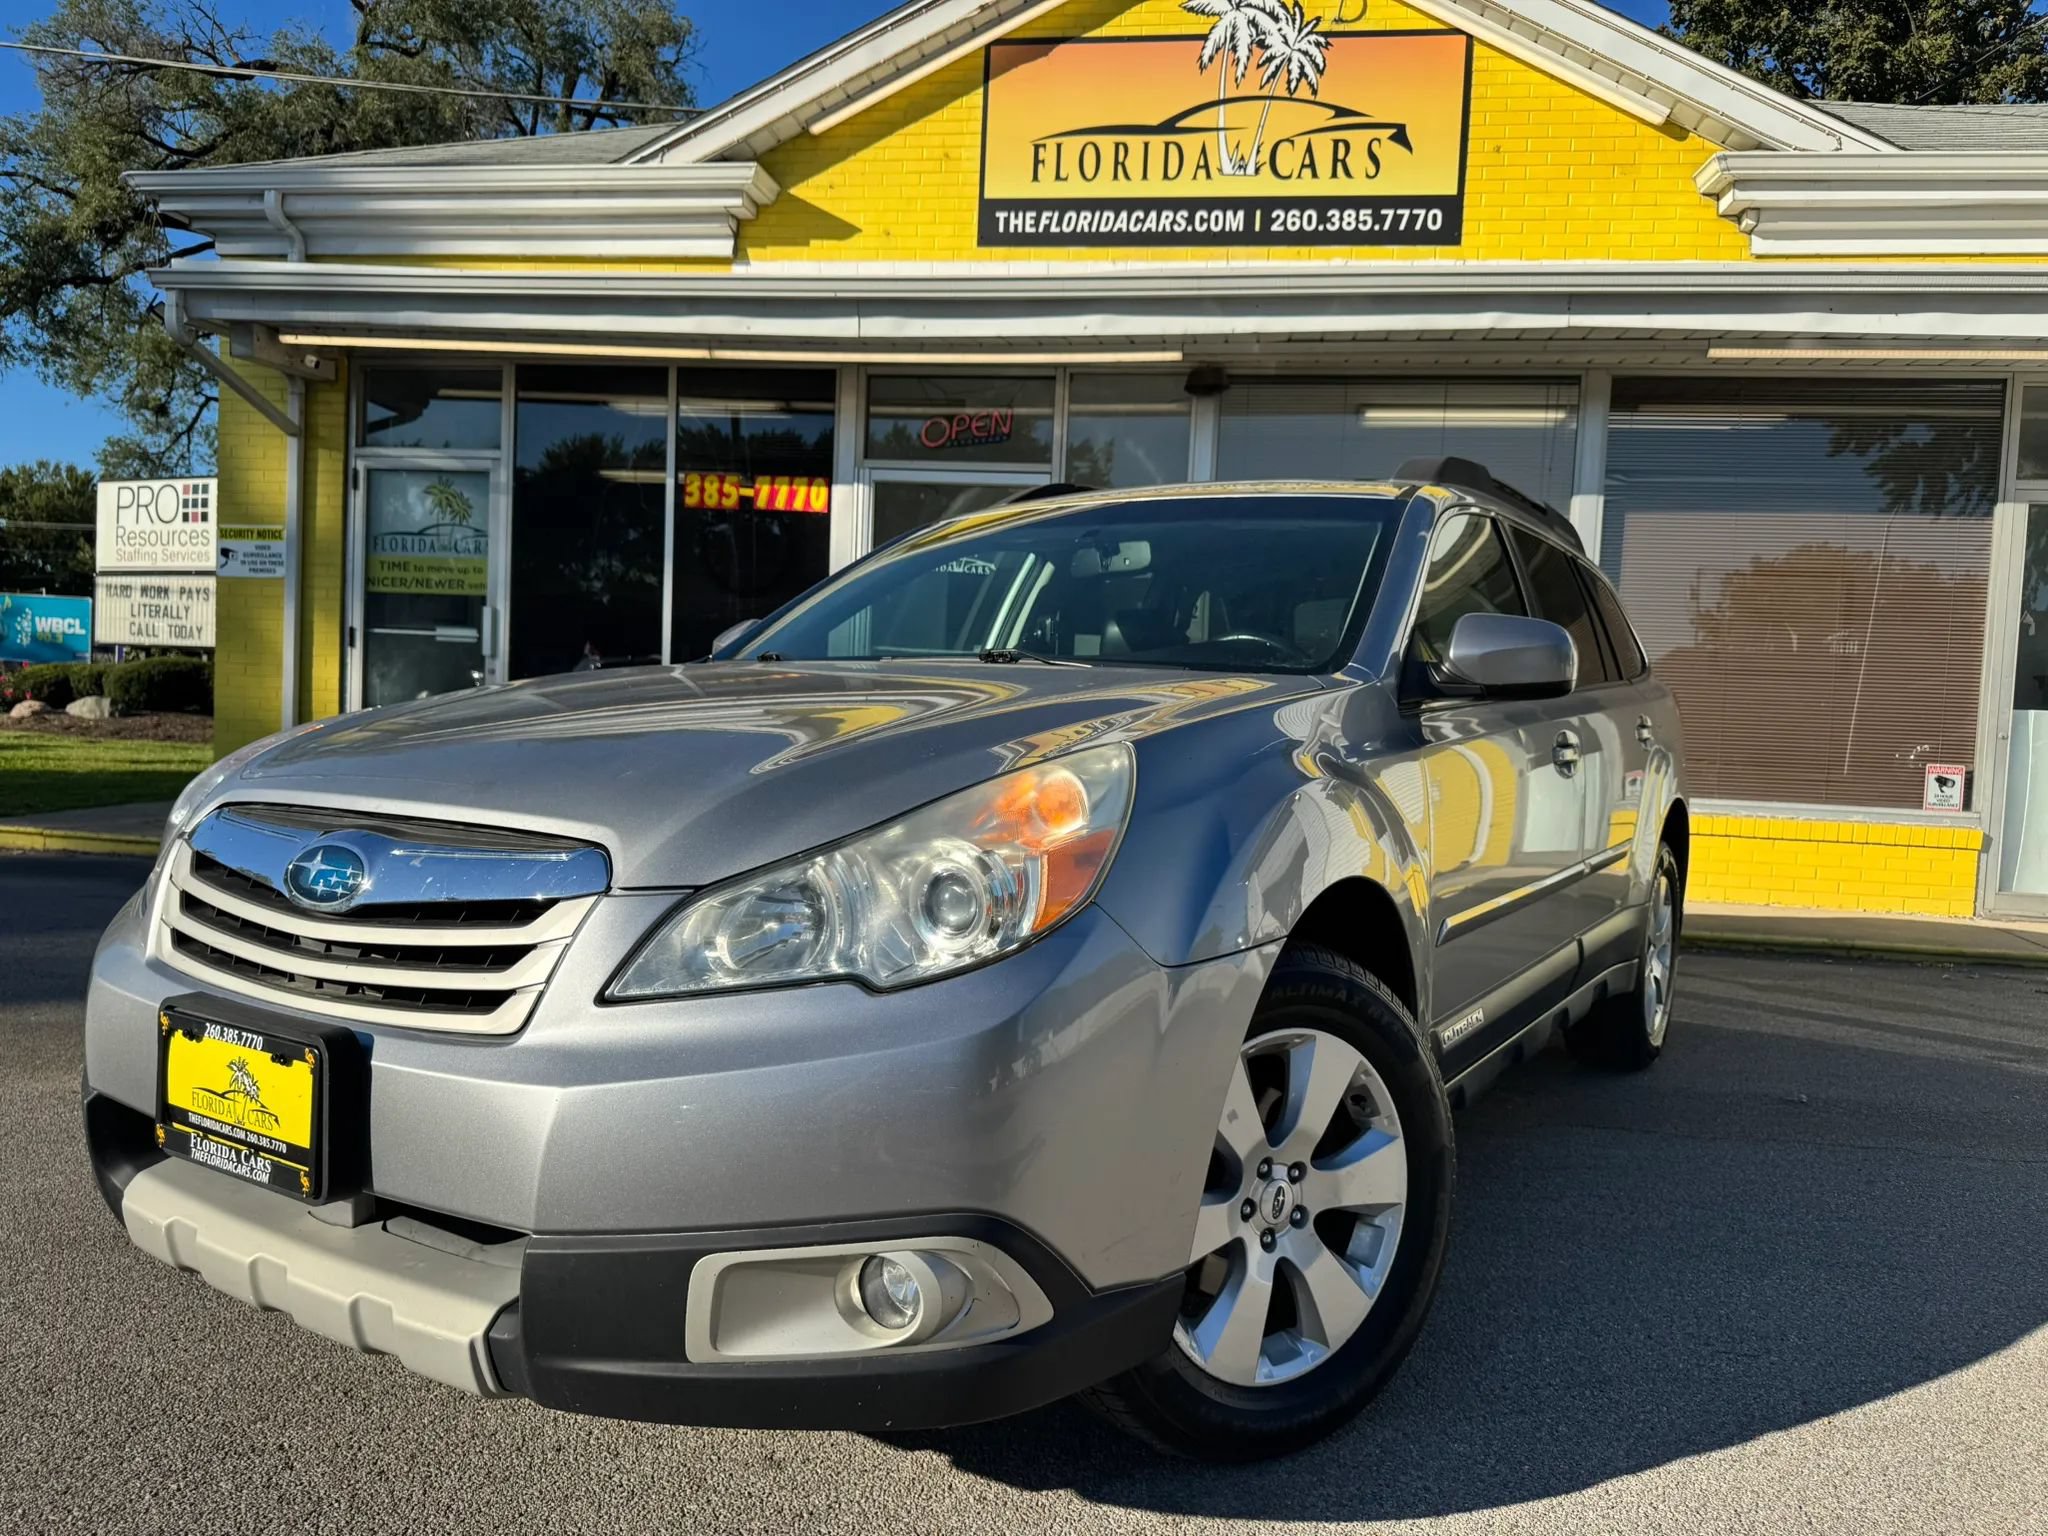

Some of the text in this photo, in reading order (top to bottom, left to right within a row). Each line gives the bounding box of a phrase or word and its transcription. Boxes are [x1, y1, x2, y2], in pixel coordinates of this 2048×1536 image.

[1031, 137, 1382, 183] FLORIDA CARS
[995, 208, 1443, 233] THEFLORIDACARS.COM 260.385.7770
[921, 408, 1013, 448] OPEN
[116, 484, 180, 525] PRO
[684, 473, 828, 511] 385-7770
[115, 526, 210, 547] Resources
[219, 528, 283, 540] SECURITY NOTICE
[373, 535, 488, 554] FLORIDA CAR
[116, 548, 210, 565] Staffing Services
[380, 560, 411, 573] TIME
[105, 583, 210, 602] HARD WORK PAYS
[130, 603, 191, 621] LITERALLY
[35, 616, 86, 635] WBCL
[129, 622, 203, 640] CALL TODAY
[204, 1022, 263, 1051] 260.385.7770
[192, 1091, 273, 1131] FLORIDA CARS
[188, 1112, 287, 1154] THEFLORIDACARS.COM 260.385.7770
[190, 1132, 272, 1173] FLORIDA CARS
[191, 1148, 270, 1184] THEFLORIDACARS.COM
